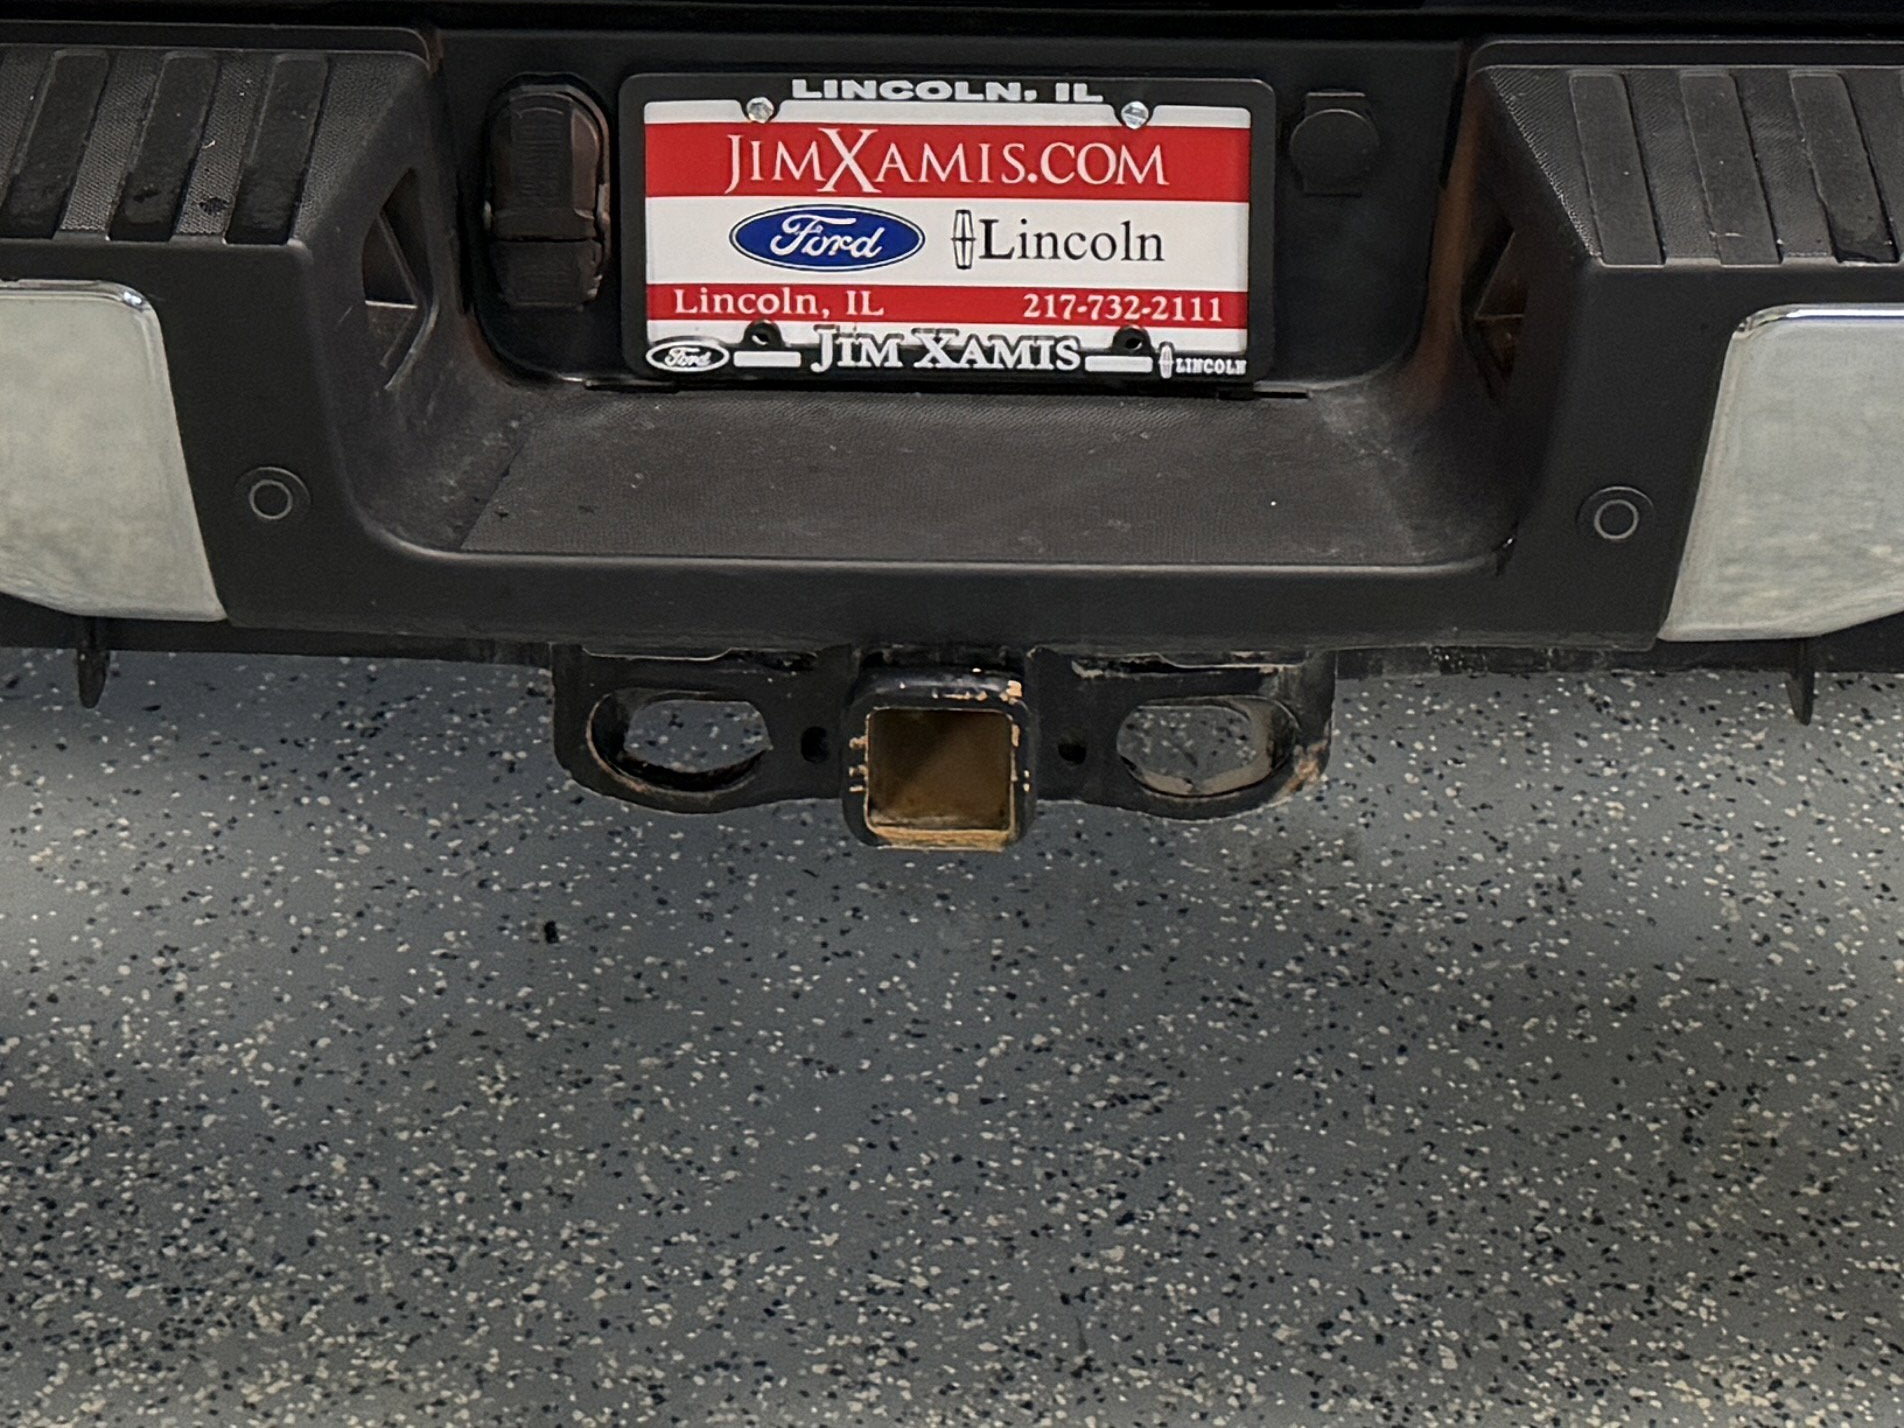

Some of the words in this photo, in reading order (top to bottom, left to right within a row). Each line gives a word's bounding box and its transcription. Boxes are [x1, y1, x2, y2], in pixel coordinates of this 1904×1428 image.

[1055, 82, 1103, 102] IL
[770, 213, 884, 258] Ford
[978, 218, 1165, 262] Lincoln
[674, 287, 830, 319] Lincoln,
[845, 290, 884, 316] IL
[1023, 293, 1222, 322] 217-732-2111
[810, 324, 904, 373] JIM
[911, 327, 1081, 371] XAMIS
[1175, 357, 1247, 375] LINCOLN
